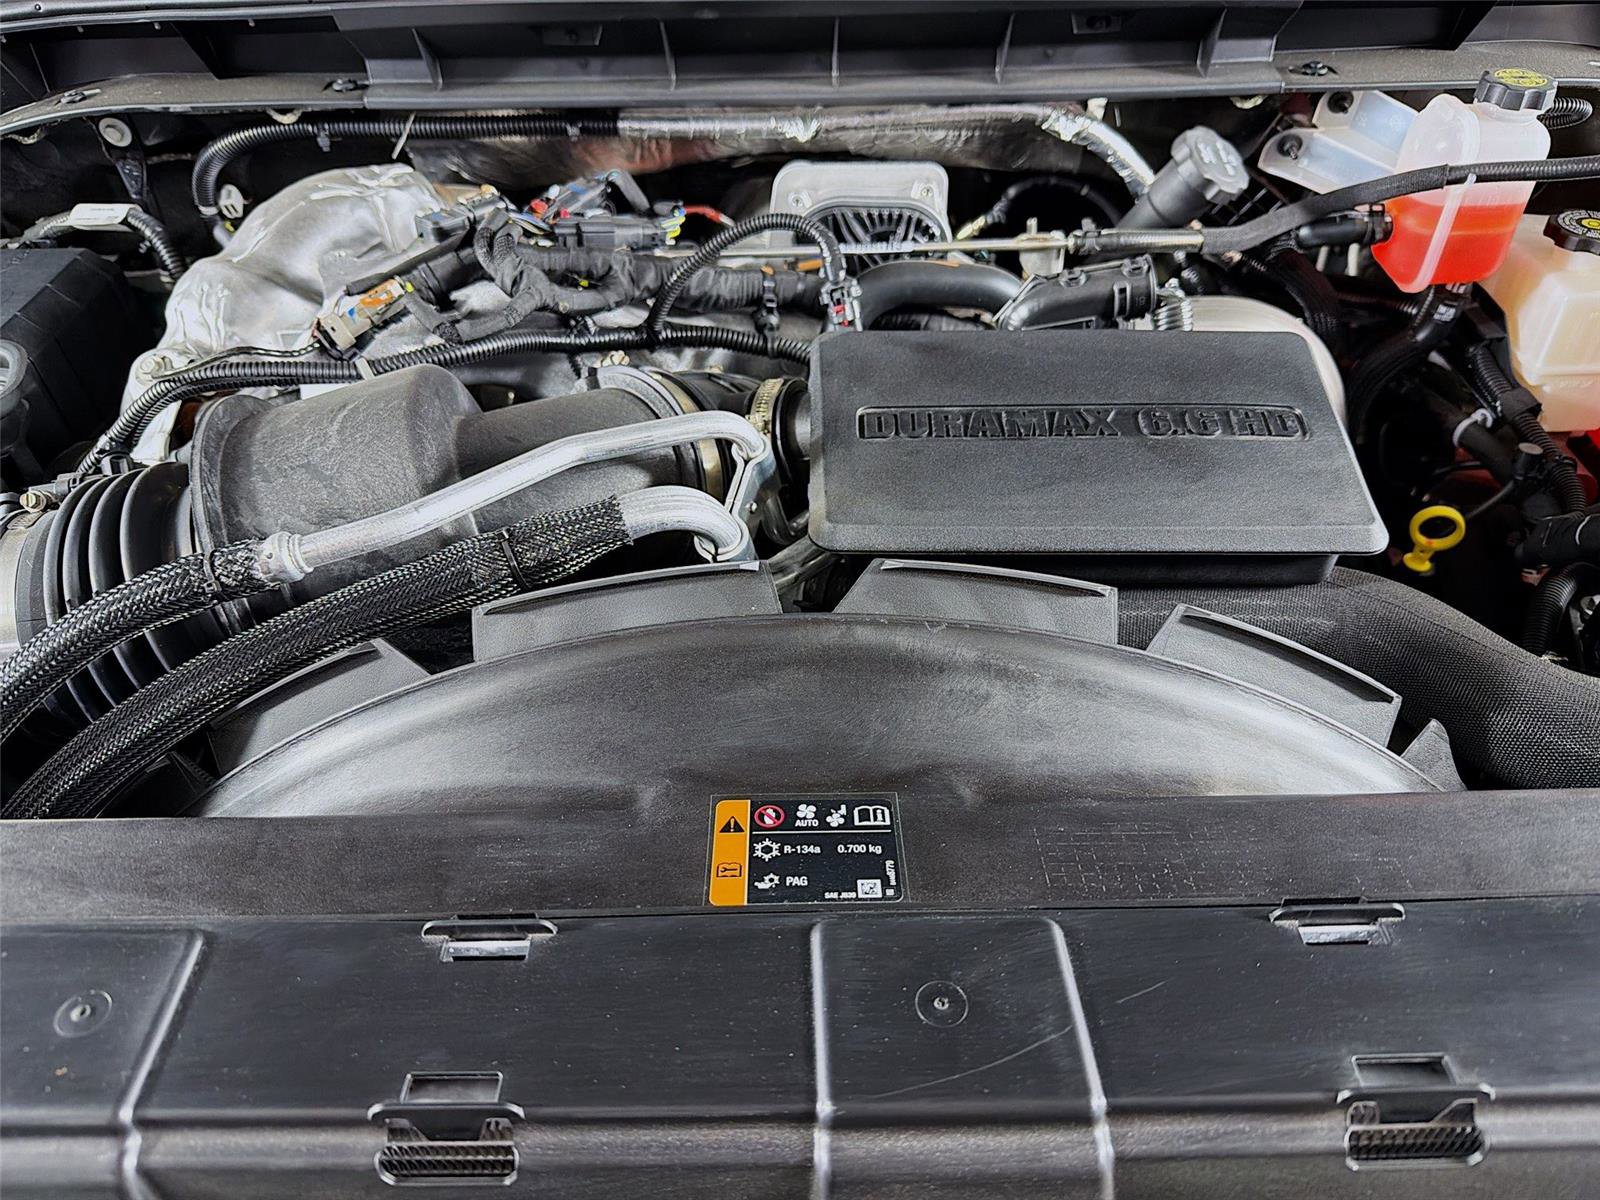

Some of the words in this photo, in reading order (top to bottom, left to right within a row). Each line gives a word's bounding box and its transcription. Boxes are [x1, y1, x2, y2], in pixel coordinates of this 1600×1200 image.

[862, 409, 1120, 438] DURAMAX
[1138, 408, 1222, 437] 6.6
[1231, 409, 1300, 437] HD
[795, 819, 819, 827] AUTO
[783, 844, 821, 854] R-134a
[837, 844, 867, 853] 0.700
[869, 844, 882, 855] kg
[786, 876, 808, 886] PAG
